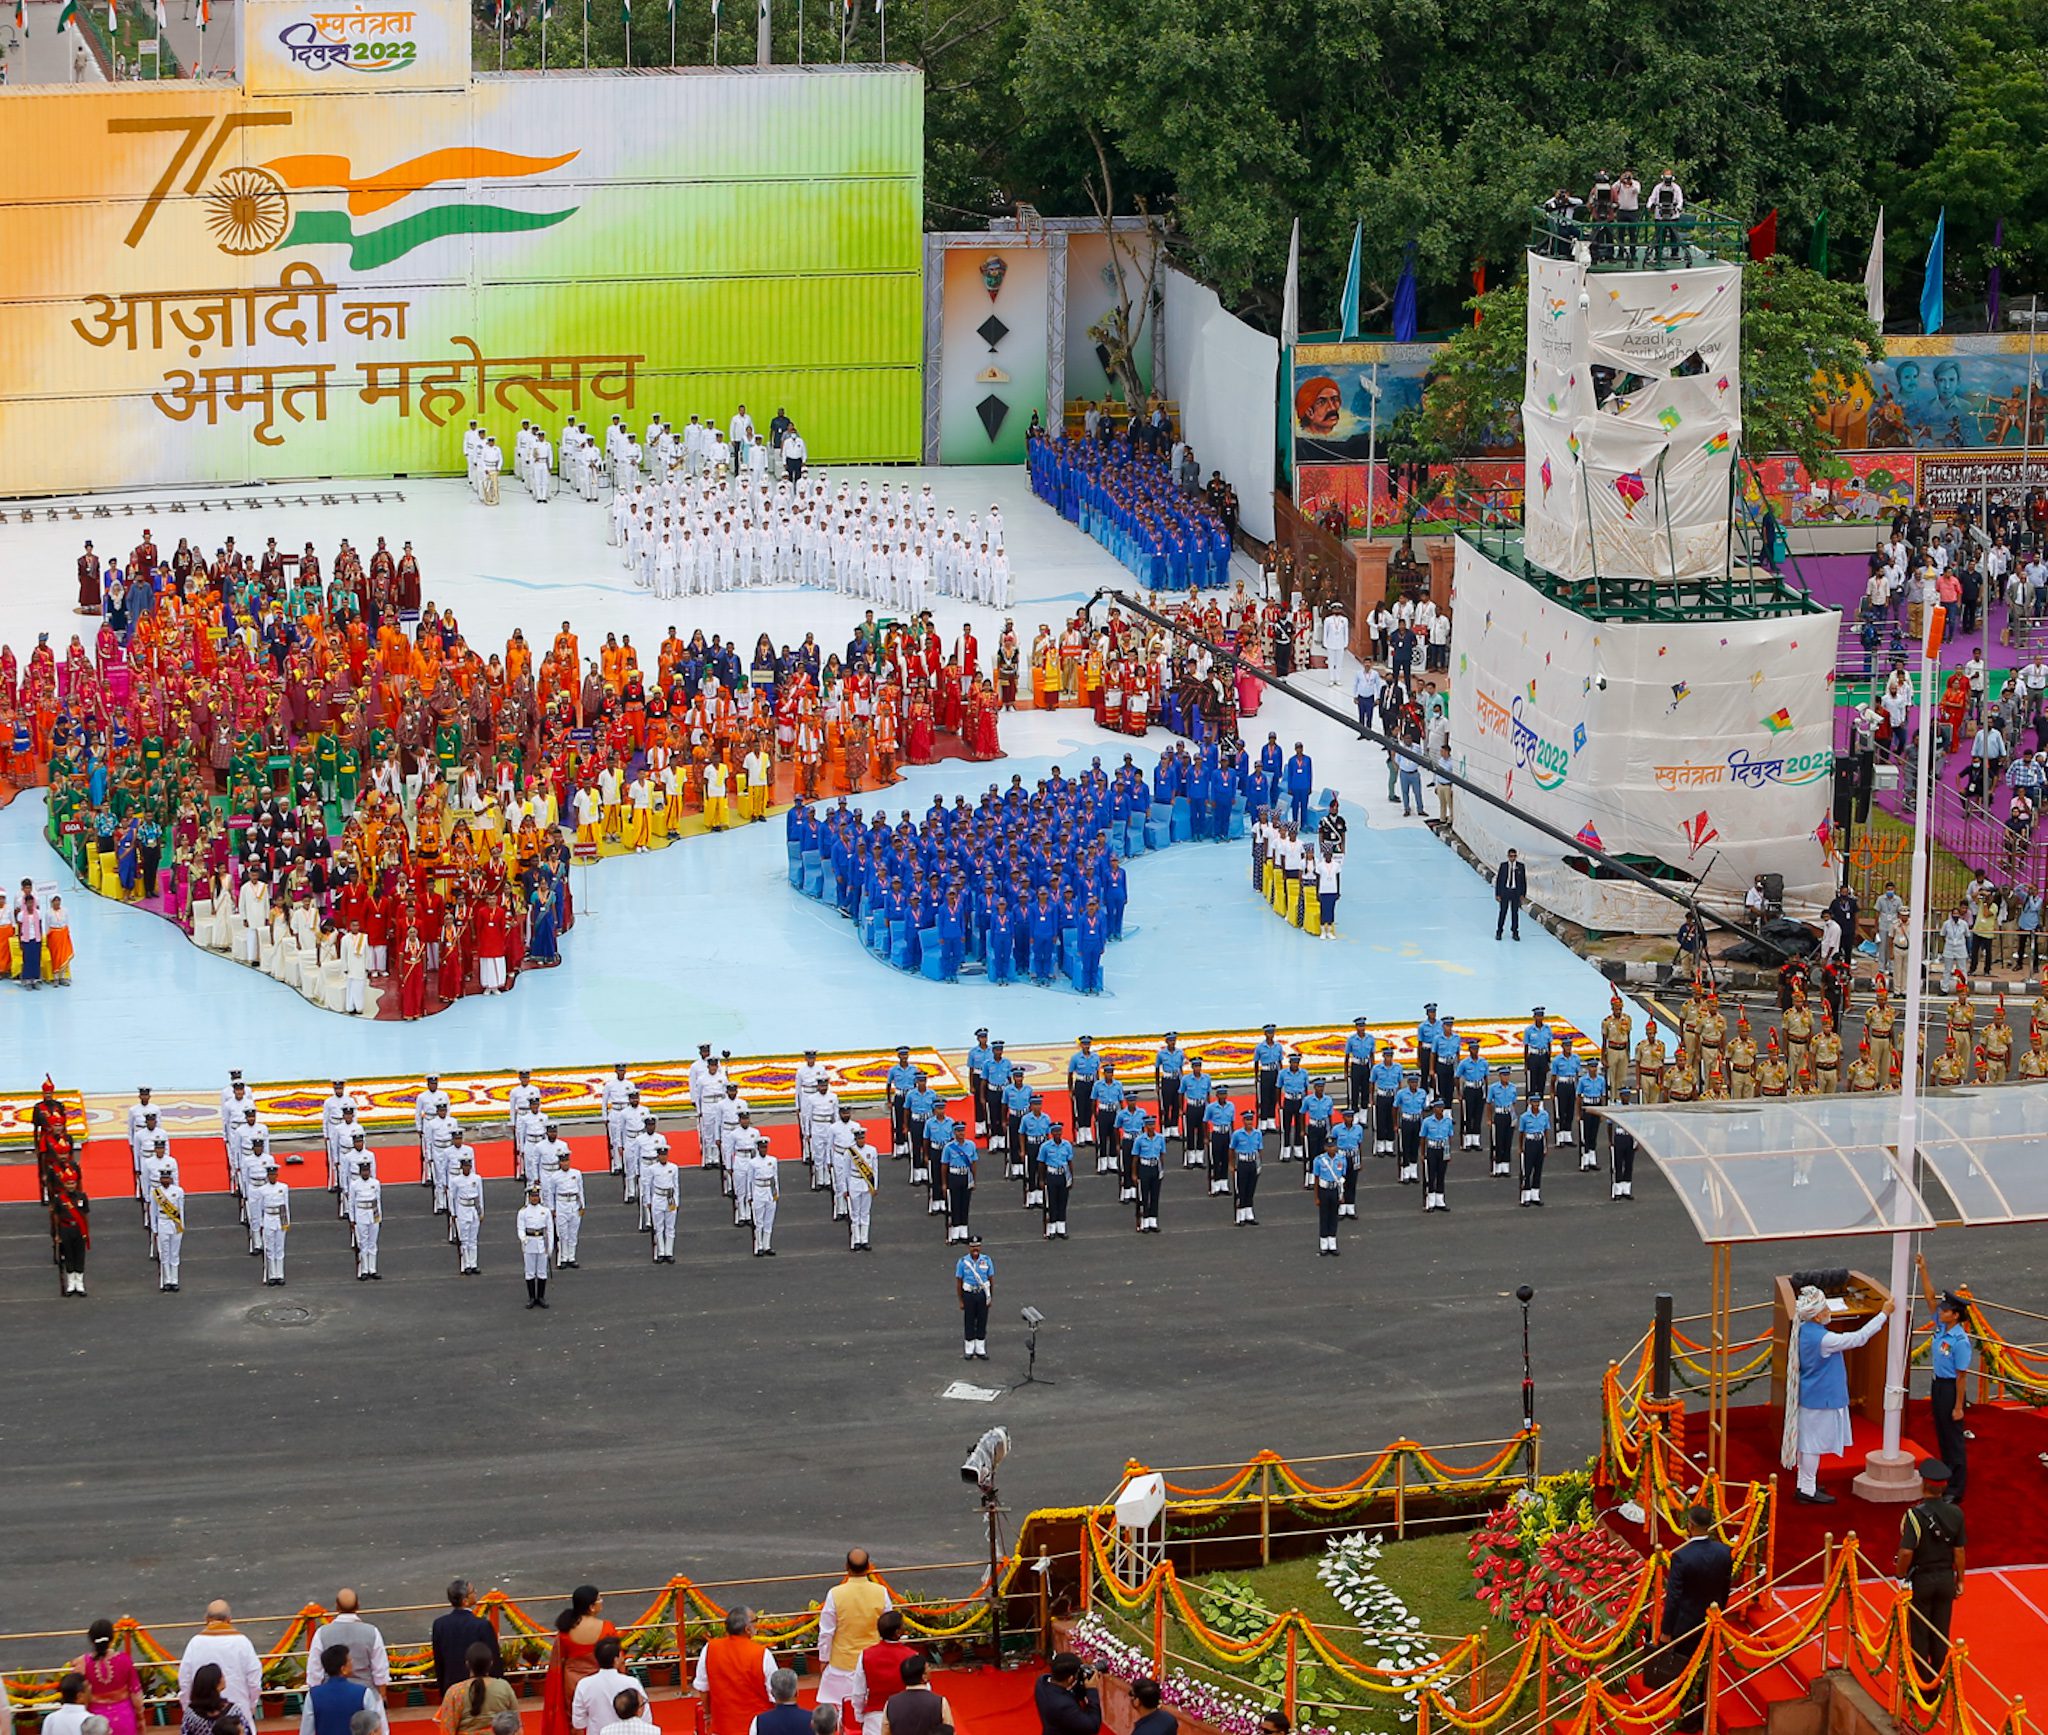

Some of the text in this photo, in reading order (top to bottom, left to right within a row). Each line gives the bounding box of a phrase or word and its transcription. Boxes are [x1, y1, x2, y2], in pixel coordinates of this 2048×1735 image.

[310, 5, 417, 43] स्वतंत्रता
[278, 22, 417, 71] दिवस 2022
[71, 261, 410, 358] आज़ादी का
[1623, 333, 1682, 346] Azadi Ka
[151, 336, 645, 446] अमृत महोत्सव
[1537, 739, 1569, 776] 2022
[1653, 748, 1835, 791] स्वतंत्रता दिवस 2022
[65, 823, 81, 832] GOA
